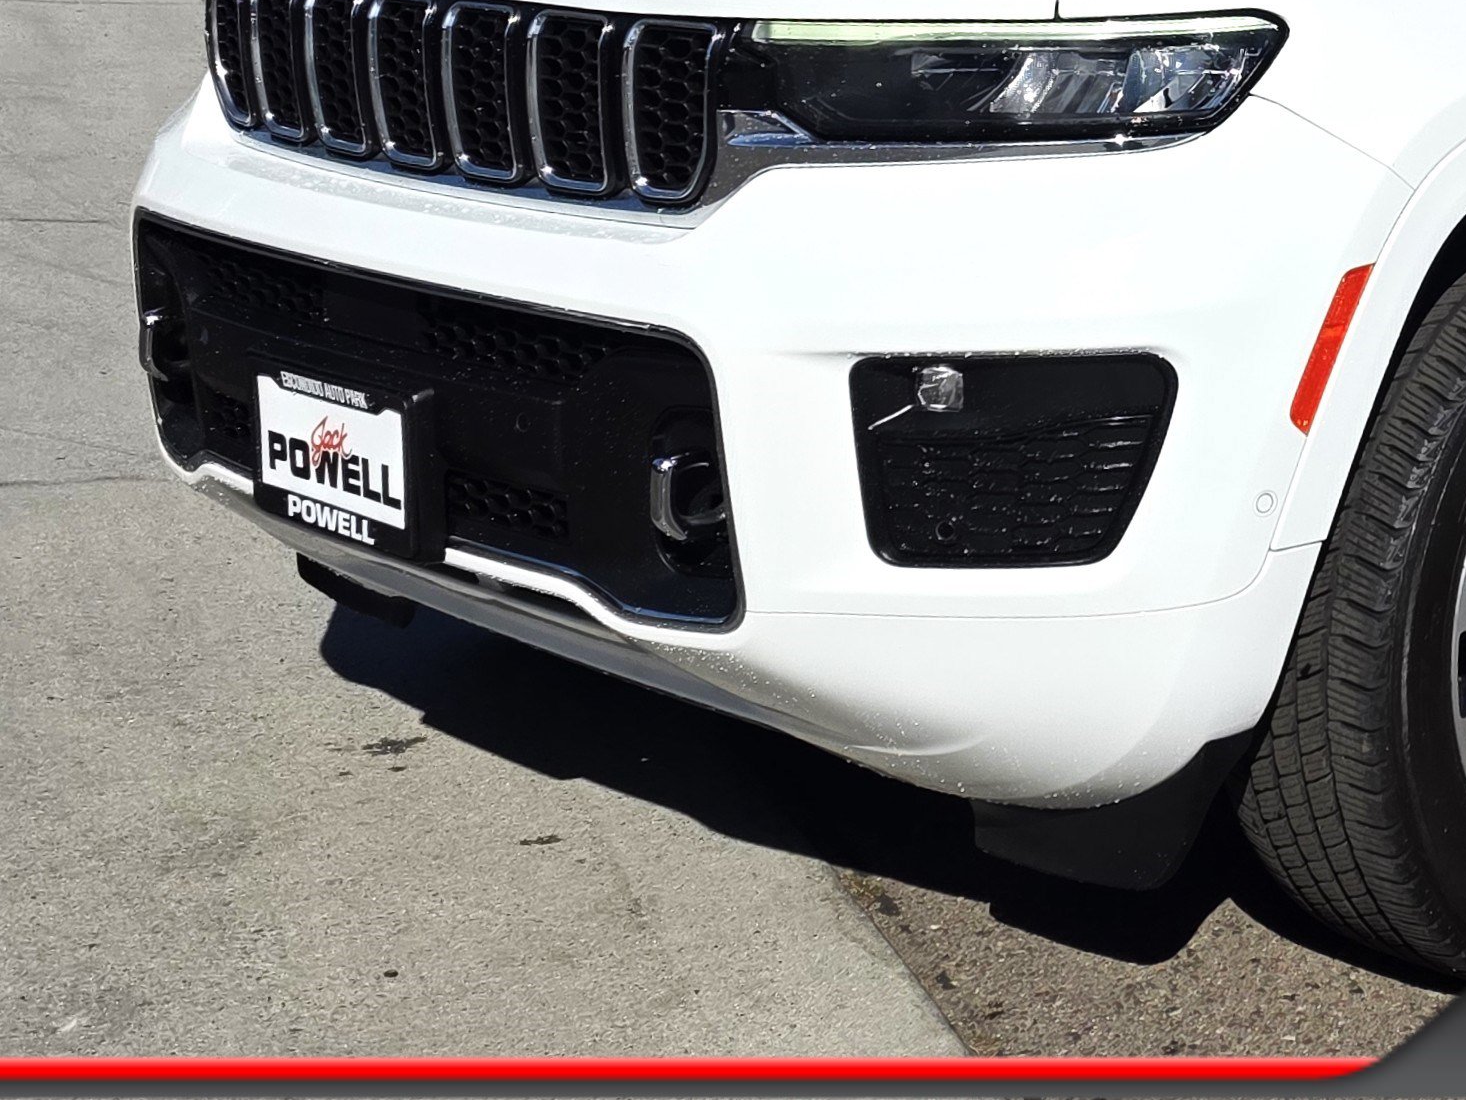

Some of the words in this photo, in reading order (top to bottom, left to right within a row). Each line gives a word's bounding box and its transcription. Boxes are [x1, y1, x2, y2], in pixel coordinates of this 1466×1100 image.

[323, 383, 345, 403] AUTO
[344, 389, 368, 409] PARK
[310, 415, 352, 467] Jack
[268, 430, 402, 510] POWELL
[287, 494, 375, 545] POWELL
